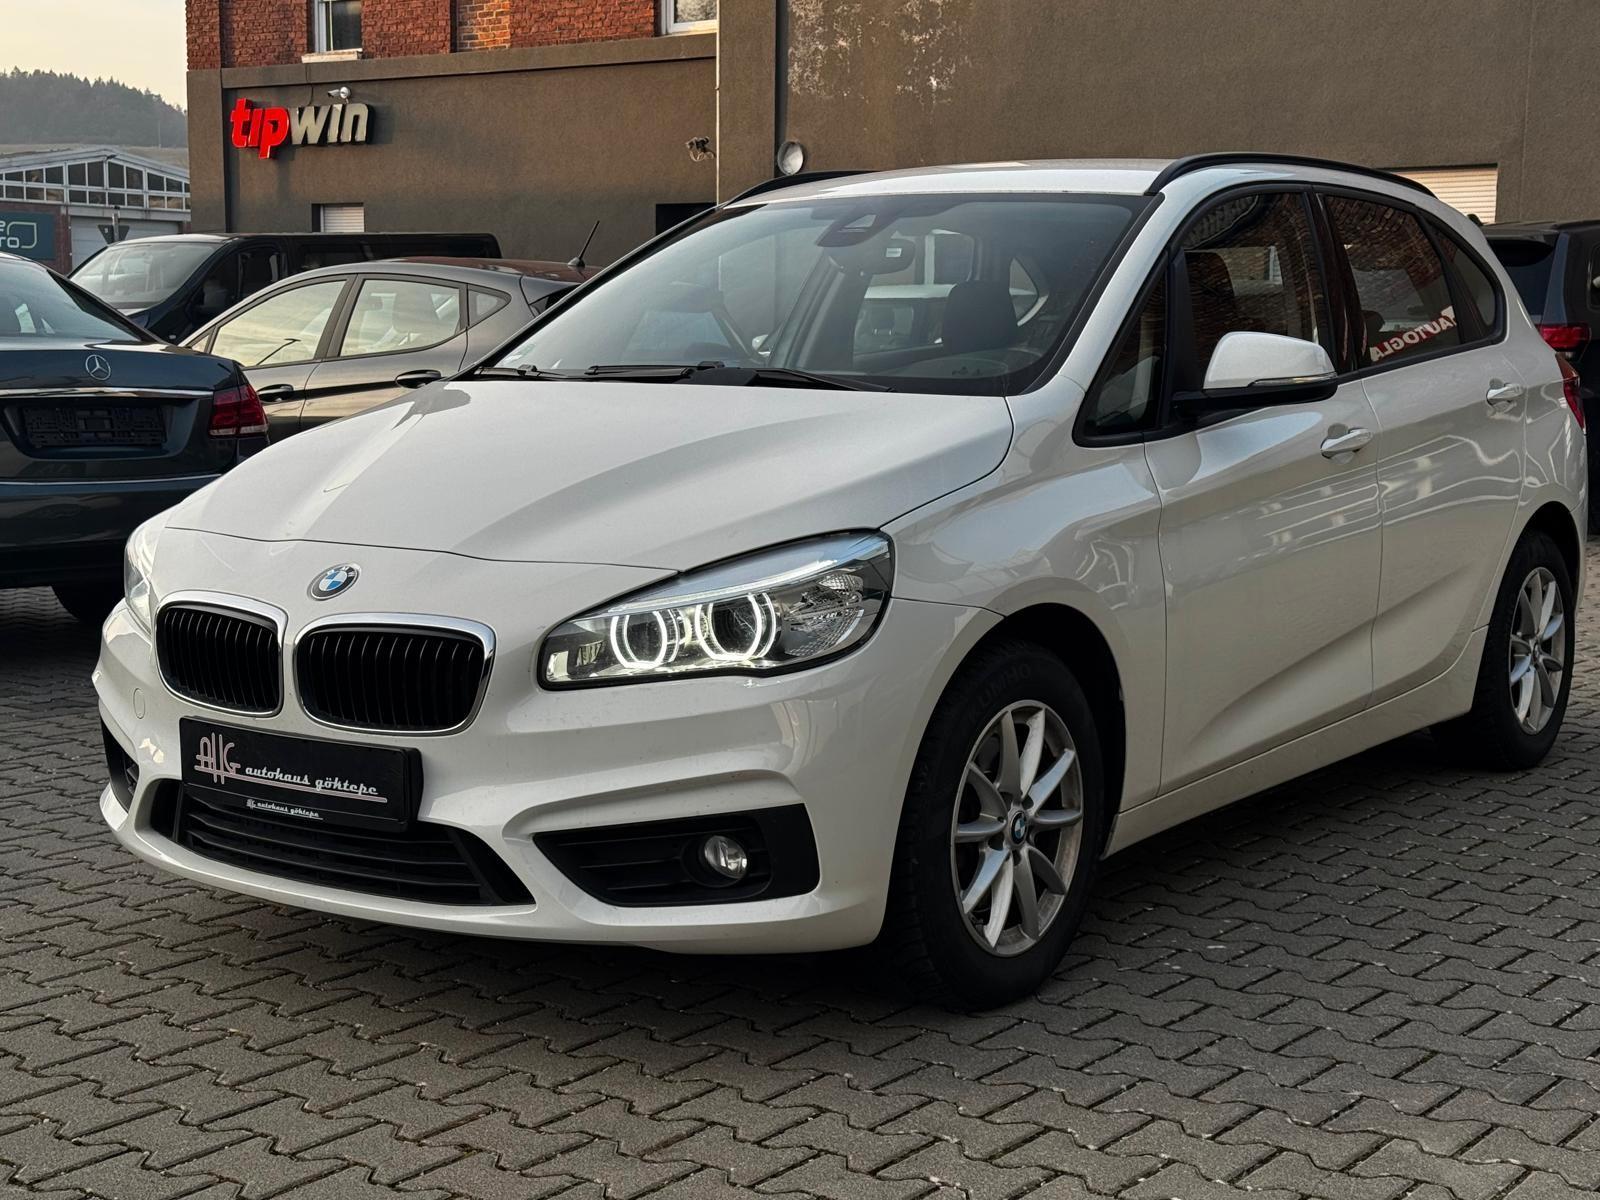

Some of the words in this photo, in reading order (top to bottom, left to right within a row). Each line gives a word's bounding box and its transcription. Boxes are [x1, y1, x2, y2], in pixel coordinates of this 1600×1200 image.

[230, 98, 370, 160] tipwin
[245, 765, 311, 785] autohaus
[315, 777, 379, 797] göktepe
